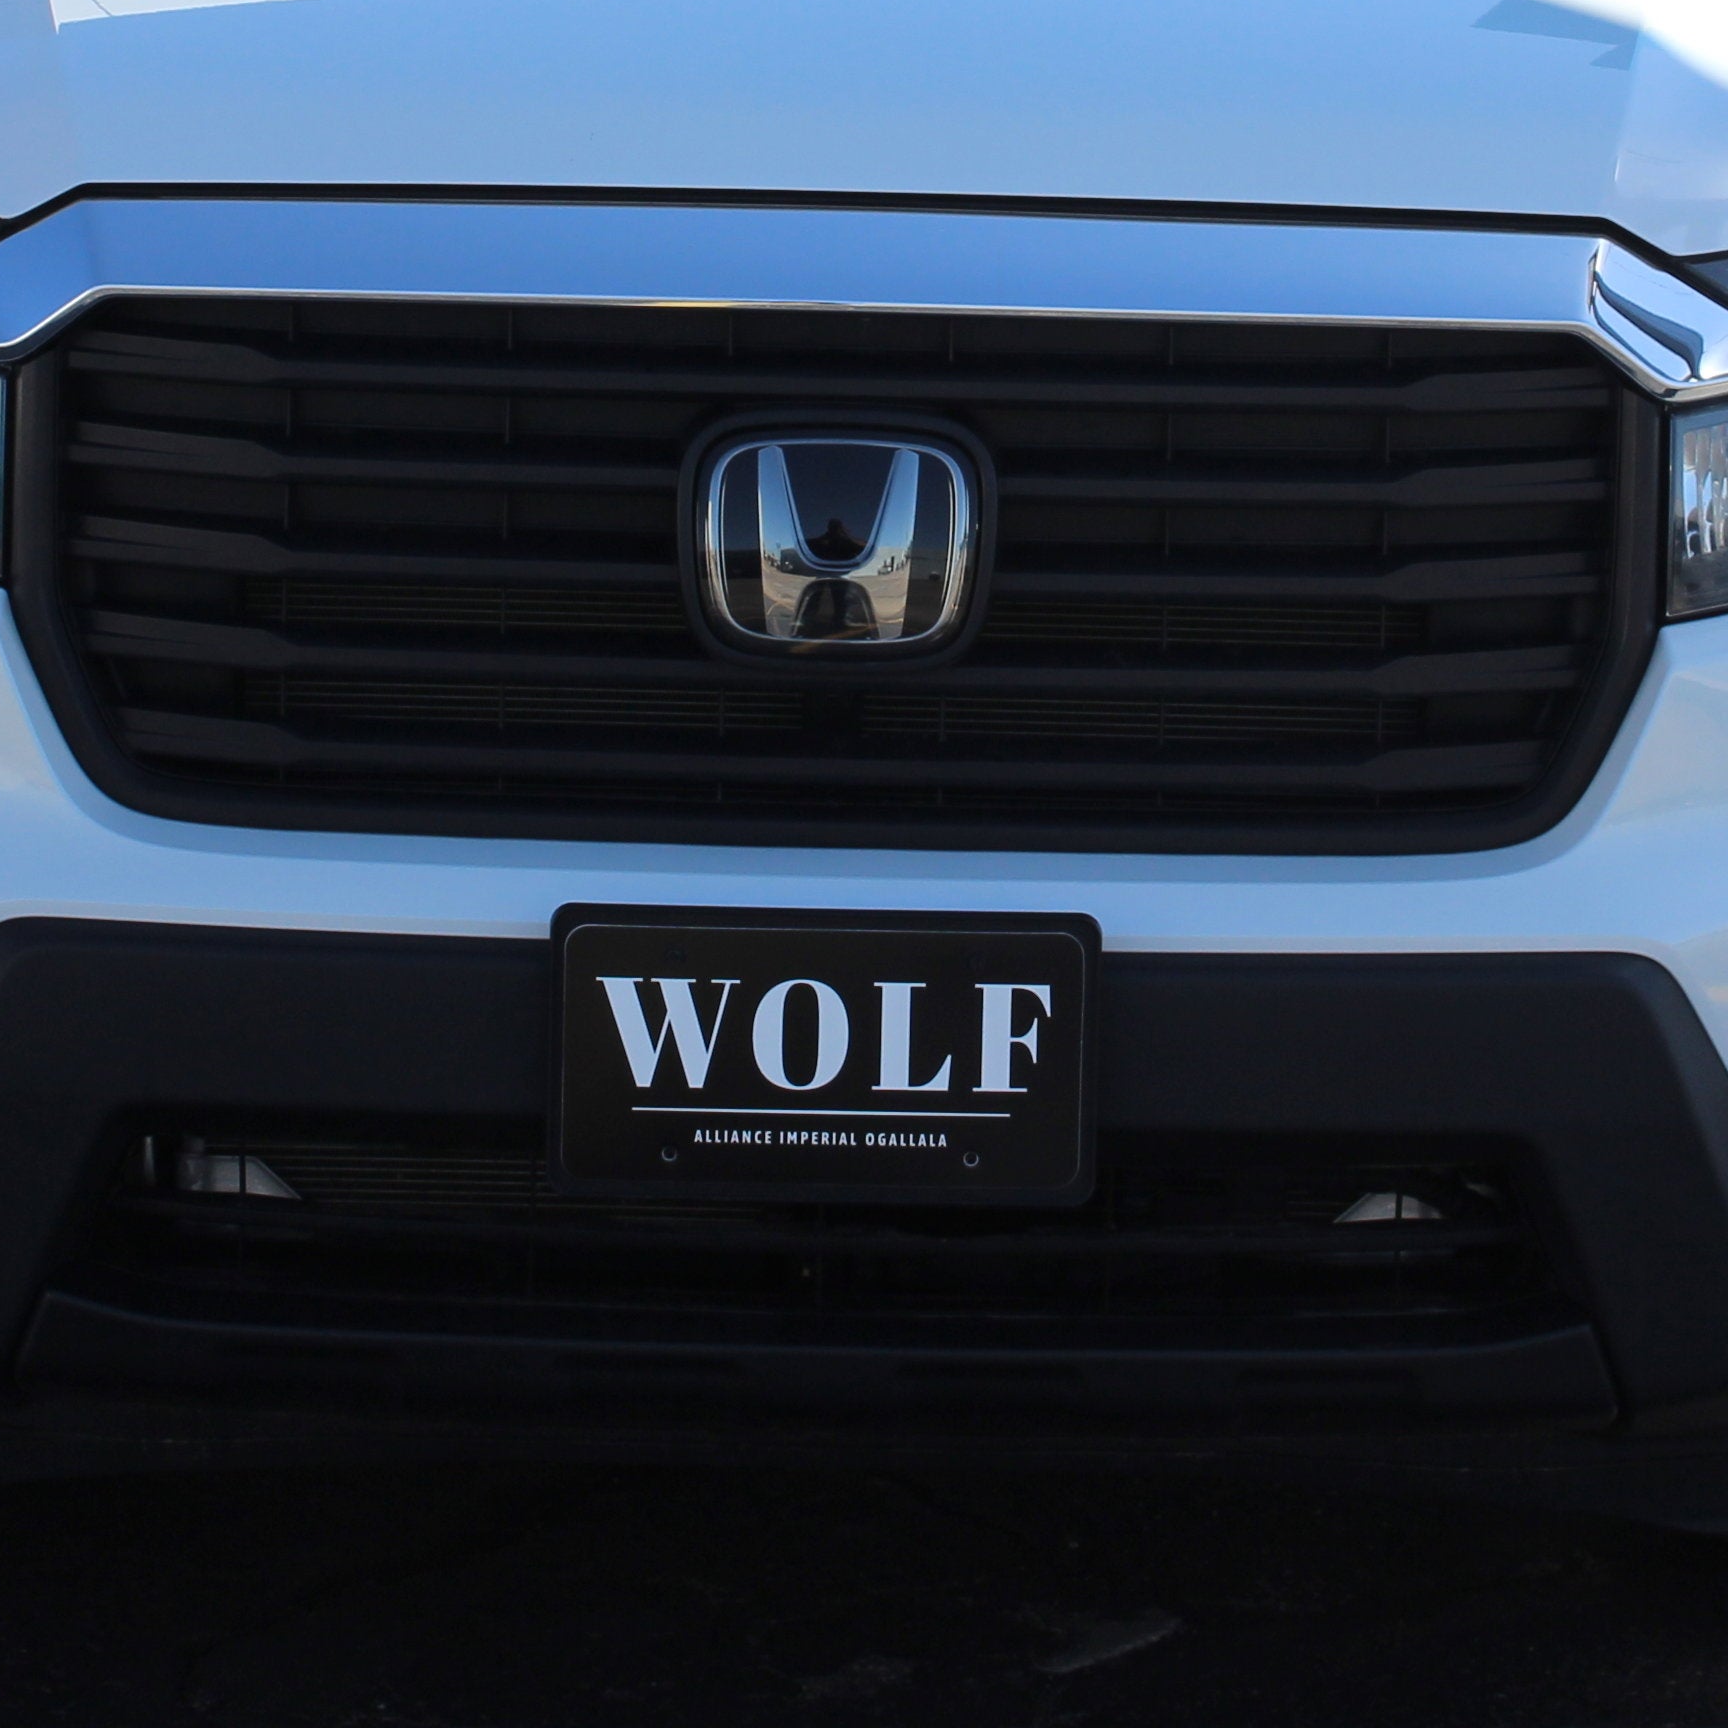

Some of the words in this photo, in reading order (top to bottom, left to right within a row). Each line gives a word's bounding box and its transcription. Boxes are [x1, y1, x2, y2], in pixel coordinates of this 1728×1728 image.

[595, 976, 1052, 1093] WOLF
[694, 1128, 773, 1145] ALLIANCE
[779, 1130, 857, 1146] IMPERIAL
[865, 1132, 948, 1148] OGALLALA
